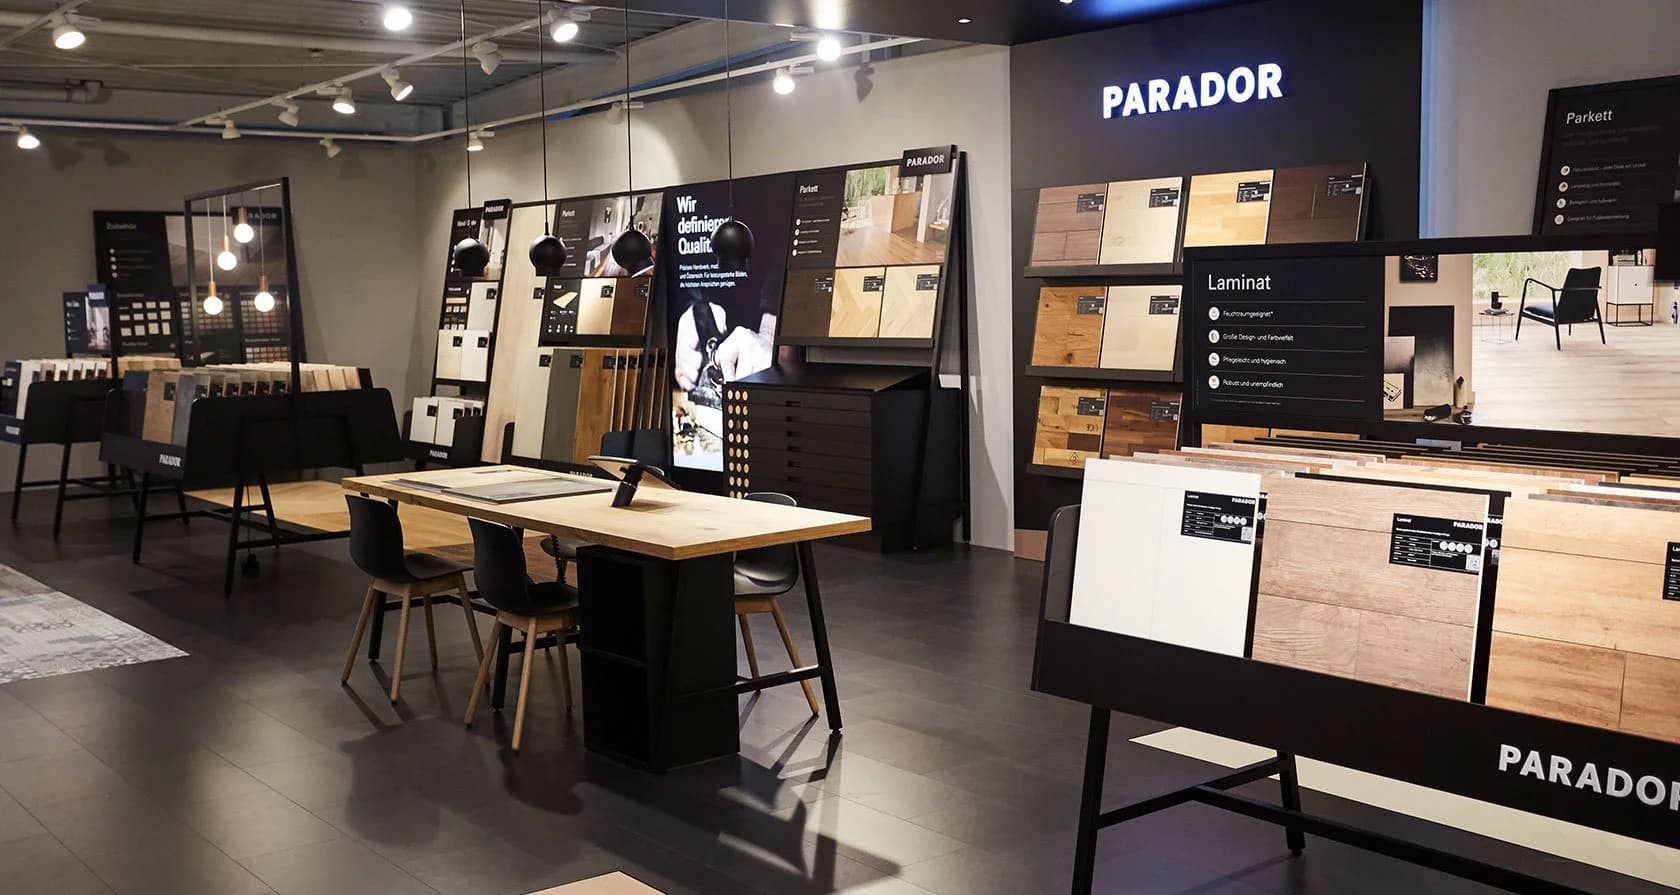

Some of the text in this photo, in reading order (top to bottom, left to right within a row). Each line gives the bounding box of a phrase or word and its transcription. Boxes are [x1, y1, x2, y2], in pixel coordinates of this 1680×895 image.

[1103, 63, 1283, 119] PARADOR
[1566, 110, 1613, 125] Parkett
[906, 154, 945, 167] PARADOR
[800, 185, 819, 194] Parkett
[676, 195, 697, 213] Wir
[677, 215, 730, 234] definier
[678, 236, 713, 255] Qualit
[1208, 273, 1272, 291] Laminat
[159, 453, 182, 467] PARADOR
[1453, 521, 1483, 530] PARADOR
